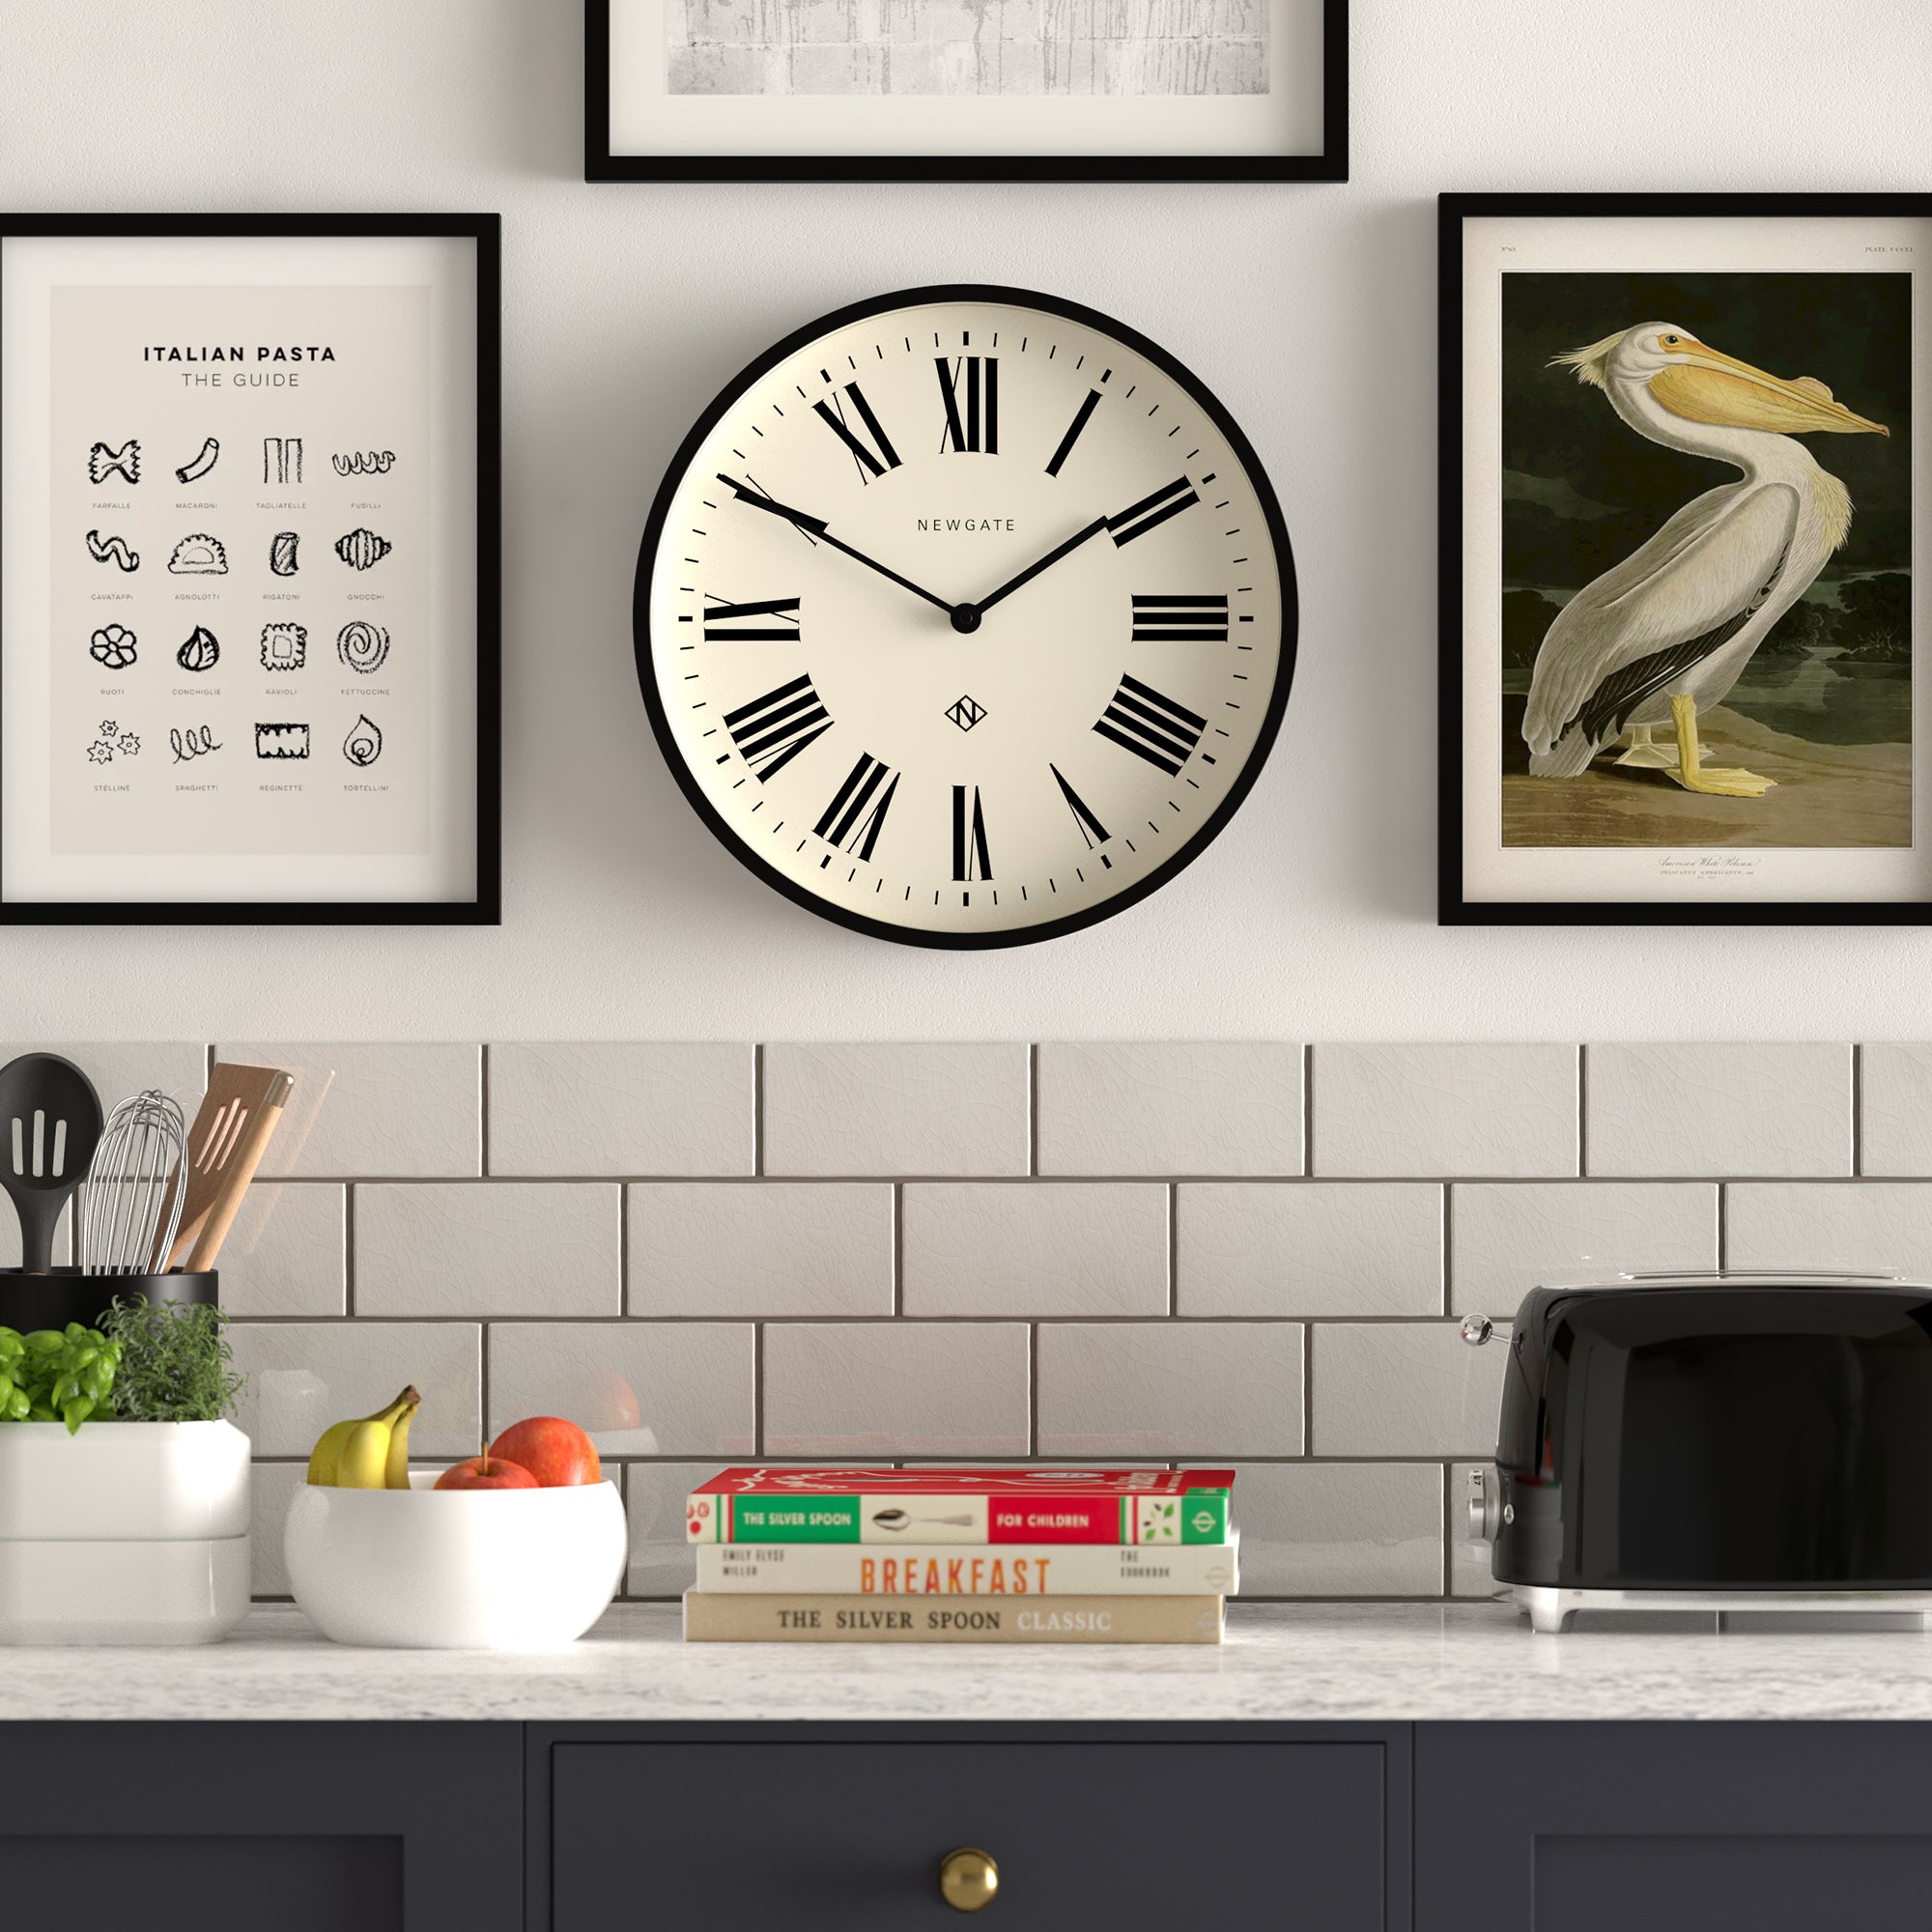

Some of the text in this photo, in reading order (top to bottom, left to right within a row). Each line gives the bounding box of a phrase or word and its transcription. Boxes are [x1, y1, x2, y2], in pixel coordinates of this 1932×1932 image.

[144, 346, 336, 362] ITALIAN PASTA
[181, 373, 299, 387] THE GUIDE
[934, 355, 1000, 456] XII
[812, 381, 904, 486] XI
[1105, 473, 1202, 550] II
[917, 518, 1015, 531] NEWGATE
[703, 592, 802, 643] IX
[1131, 594, 1229, 642] III
[171, 688, 222, 696] CONCHIGLIE
[743, 1512, 852, 1526] THE SILVER SPOON
[996, 1514, 1090, 1528] FOR CHILDREN
[861, 1558, 1051, 1594] BREAKFAST
[778, 1610, 1112, 1632] THE SILVER SPOON CLASSIC
